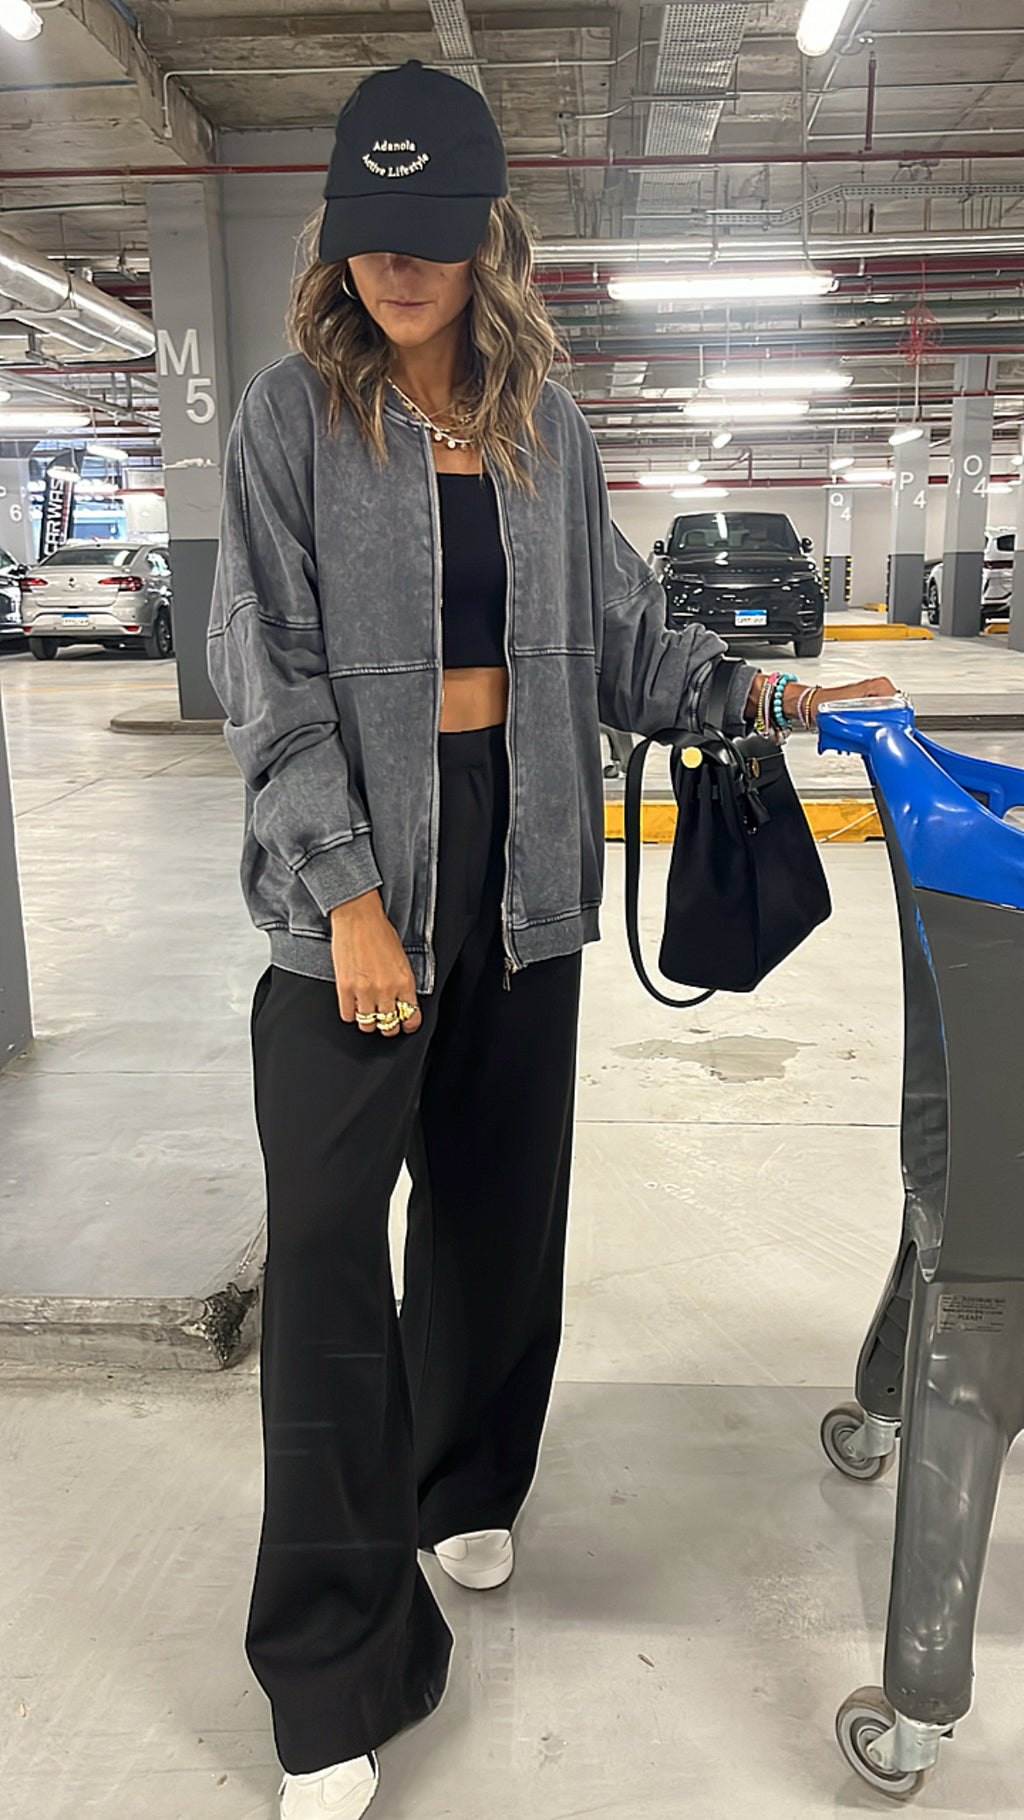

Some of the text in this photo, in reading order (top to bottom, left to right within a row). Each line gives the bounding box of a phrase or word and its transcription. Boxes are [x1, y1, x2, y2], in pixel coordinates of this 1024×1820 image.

[372, 139, 416, 151] Adanola
[362, 152, 430, 177] Active Lifestyle
[157, 328, 200, 376] M
[186, 378, 215, 424] 5
[900, 471, 914, 490] P
[972, 477, 988, 498] 4
[47, 466, 65, 520] WAS
[830, 492, 844, 507] Q
[913, 490, 926, 509] 4
[9, 504, 22, 521] 6
[840, 507, 852, 521] 4
